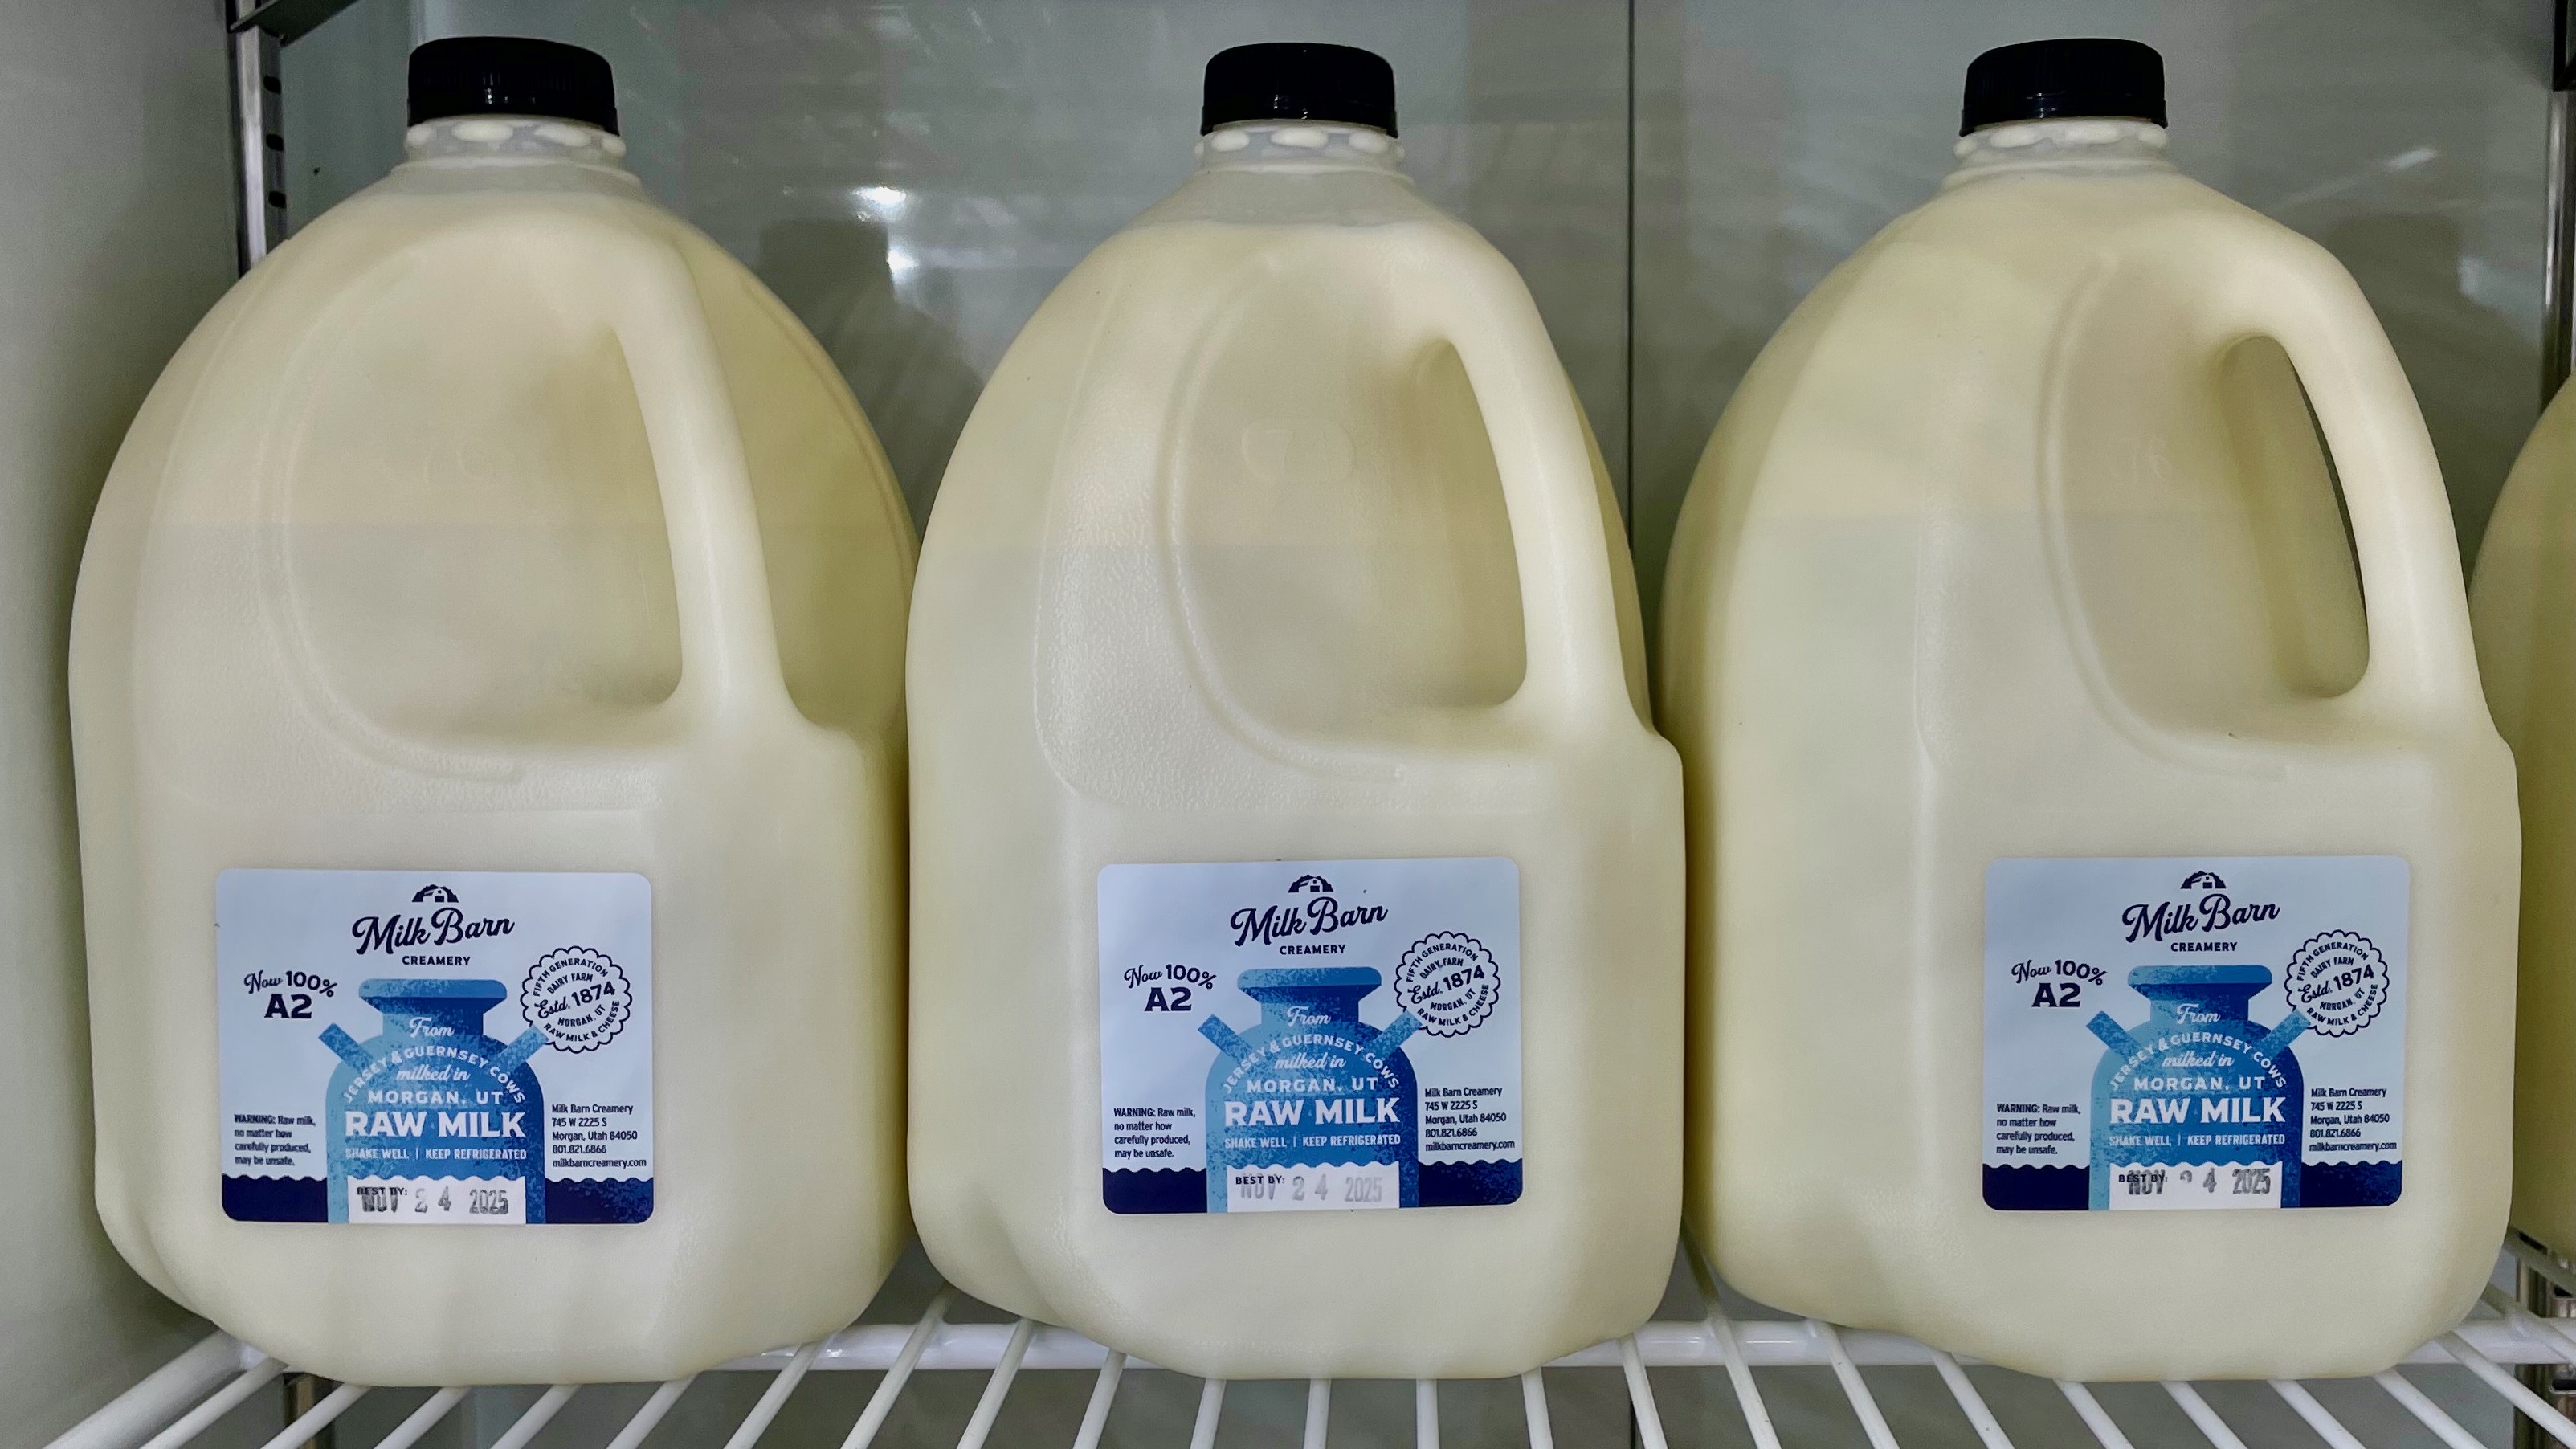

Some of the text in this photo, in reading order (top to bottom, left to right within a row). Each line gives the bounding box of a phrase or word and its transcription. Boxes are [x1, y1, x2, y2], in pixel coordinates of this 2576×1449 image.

[1231, 896, 1389, 947] Milk Barn
[2121, 893, 2281, 943] Milk Barn
[352, 907, 515, 954] Milk Barn
[1279, 944, 1346, 955] CREAMERY
[2170, 941, 2238, 952] CREAMERY
[402, 956, 471, 965] CREAMERY
[1406, 943, 1479, 982] FIFTH GENERATION
[1419, 957, 1464, 979] DAIRY FARM
[2296, 942, 2369, 981] FIFTH GENERATION
[533, 958, 608, 997] FIFTH GENERATION
[1124, 964, 1217, 990] Now 100%
[2011, 959, 2108, 986] Now 100%
[2333, 964, 2374, 990] 1874
[243, 969, 337, 998] Now 100%
[547, 973, 593, 994] DAIRY FARM
[1407, 965, 1484, 1004] Estd. 1874
[571, 981, 615, 1006] 1874
[1144, 986, 1192, 1012] A2
[1465, 988, 1476, 1000] UT
[2031, 982, 2081, 1008] A2
[263, 993, 312, 1018] A2
[594, 1004, 606, 1016] UT
[1417, 1008, 1437, 1023] RAW
[1439, 1016, 1461, 1026] MILK
[1468, 984, 1489, 1017] CHEESE
[2176, 1003, 2221, 1024] From
[2306, 984, 2378, 1026] RAW MILK & CHEESE
[544, 1022, 565, 1039] RAW
[565, 1034, 590, 1042] MILK
[598, 1000, 620, 1033] CHEESE
[1287, 1005, 1332, 1027] From
[409, 1017, 455, 1038] From
[1223, 1033, 1399, 1095] JERSEY & GUERNSEY COWS
[1274, 1052, 1347, 1069] milked in
[2109, 1031, 2287, 1091] JERSEY & GUERNSEY COWS
[2162, 1050, 2235, 1067] milked in
[343, 1045, 525, 1104] JERSEY & GUERNSEY COWS
[396, 1063, 471, 1081] milked in
[1352, 1077, 1378, 1091] UT
[1425, 1087, 1502, 1097] Milk Barn Creamery
[2134, 1076, 2265, 1091] MORGAN, UT
[476, 1091, 504, 1104] UT
[1425, 1100, 1478, 1111] 745 W 2225 S
[552, 1104, 634, 1115] Milk Barn Creamery
[1113, 1108, 1195, 1118] WARNING: Raw milk,
[1224, 1097, 1400, 1126] RAW MILK
[1425, 1112, 1507, 1126] Morgan, Utah 84050
[1997, 1104, 2081, 1115] WARNING: Raw milk,
[2109, 1096, 2286, 1124] RAW MILK
[345, 1111, 526, 1137] RAW MILK
[552, 1117, 607, 1127] 745 W 2225 S
[1126, 1121, 1153, 1131] matter
[1155, 1121, 1172, 1130] how
[2009, 1117, 2038, 1126] matter
[2039, 1117, 2057, 1126] how
[552, 1130, 638, 1142] Morgan, Utah 84050
[1114, 1134, 1190, 1146] carefully produced,
[1225, 1133, 1401, 1149] SHAKE WELL KEEP REFRIGERATED
[1425, 1127, 1478, 1138] 801.821.6866
[1996, 1130, 2075, 1142] carefully produced,
[2109, 1133, 2285, 1146] SHAKE WELL KEEP REFRIGERATED
[425, 1149, 527, 1160] KEEP REFRIGERATED
[552, 1145, 607, 1154] 801.821.6866
[1115, 1148, 1174, 1160] may be unsafe.
[1426, 1141, 1516, 1151] milkbarncreamery.com
[1996, 1145, 2058, 1156] may be unsafe.
[1235, 1175, 1285, 1185] BEST BY:
[1345, 1176, 1382, 1202] 2025
[2232, 1168, 2272, 1194] 2025
[469, 1189, 508, 1214] 2025
